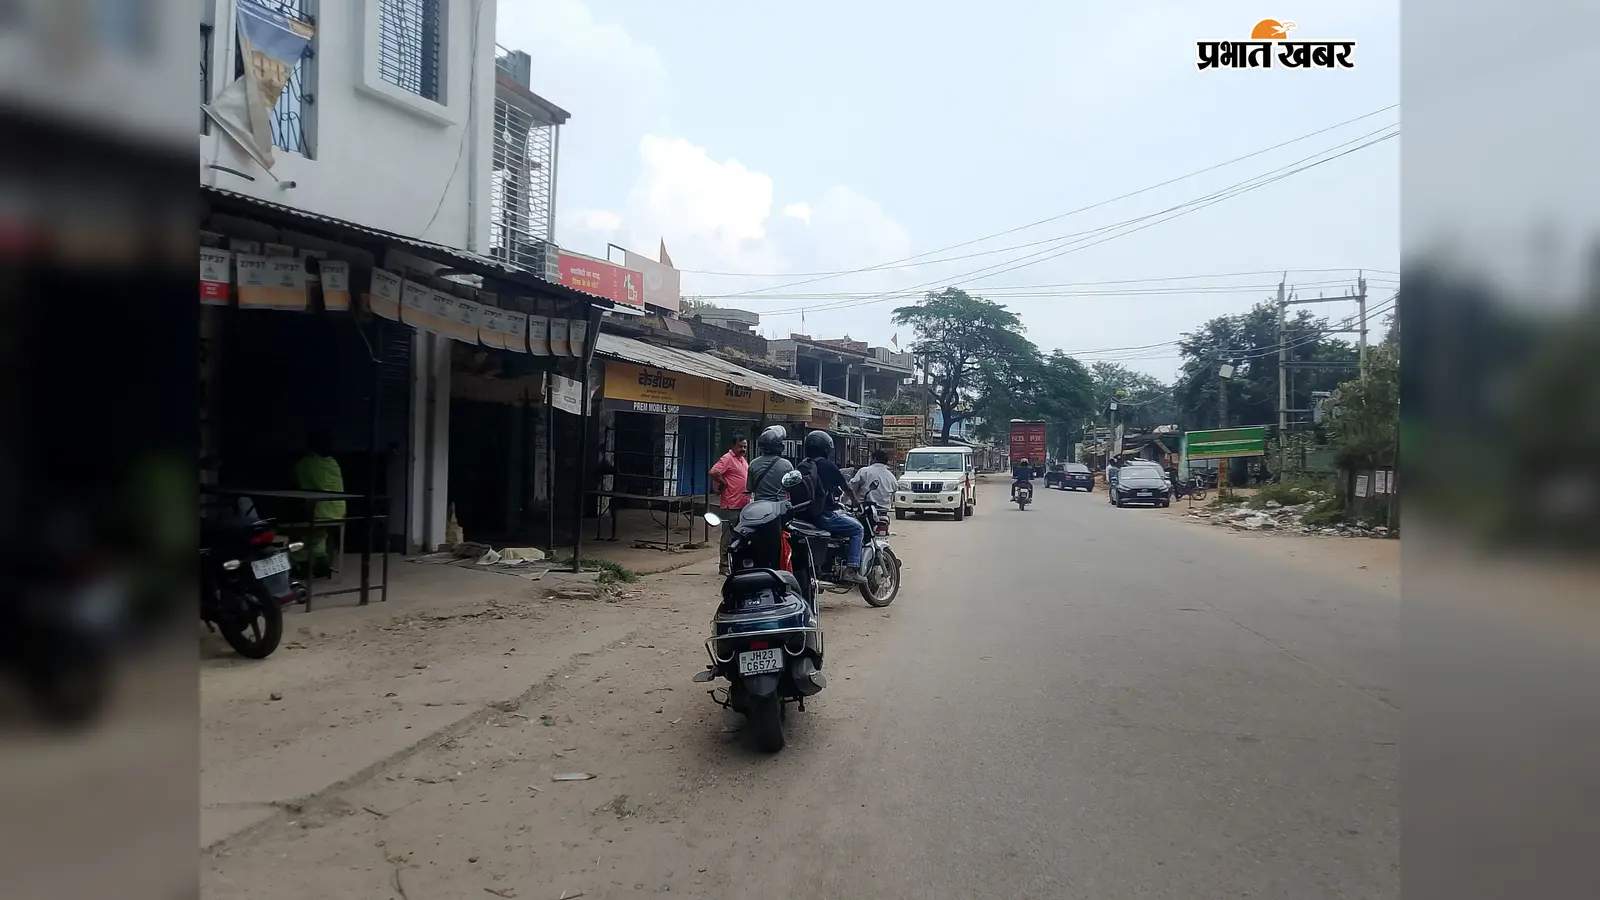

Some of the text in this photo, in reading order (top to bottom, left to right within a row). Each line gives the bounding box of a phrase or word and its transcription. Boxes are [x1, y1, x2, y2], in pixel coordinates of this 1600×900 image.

[633, 401, 680, 414] PREM MOBILE SHOP
[750, 650, 774, 661] JH23
[747, 659, 777, 671] C6572
